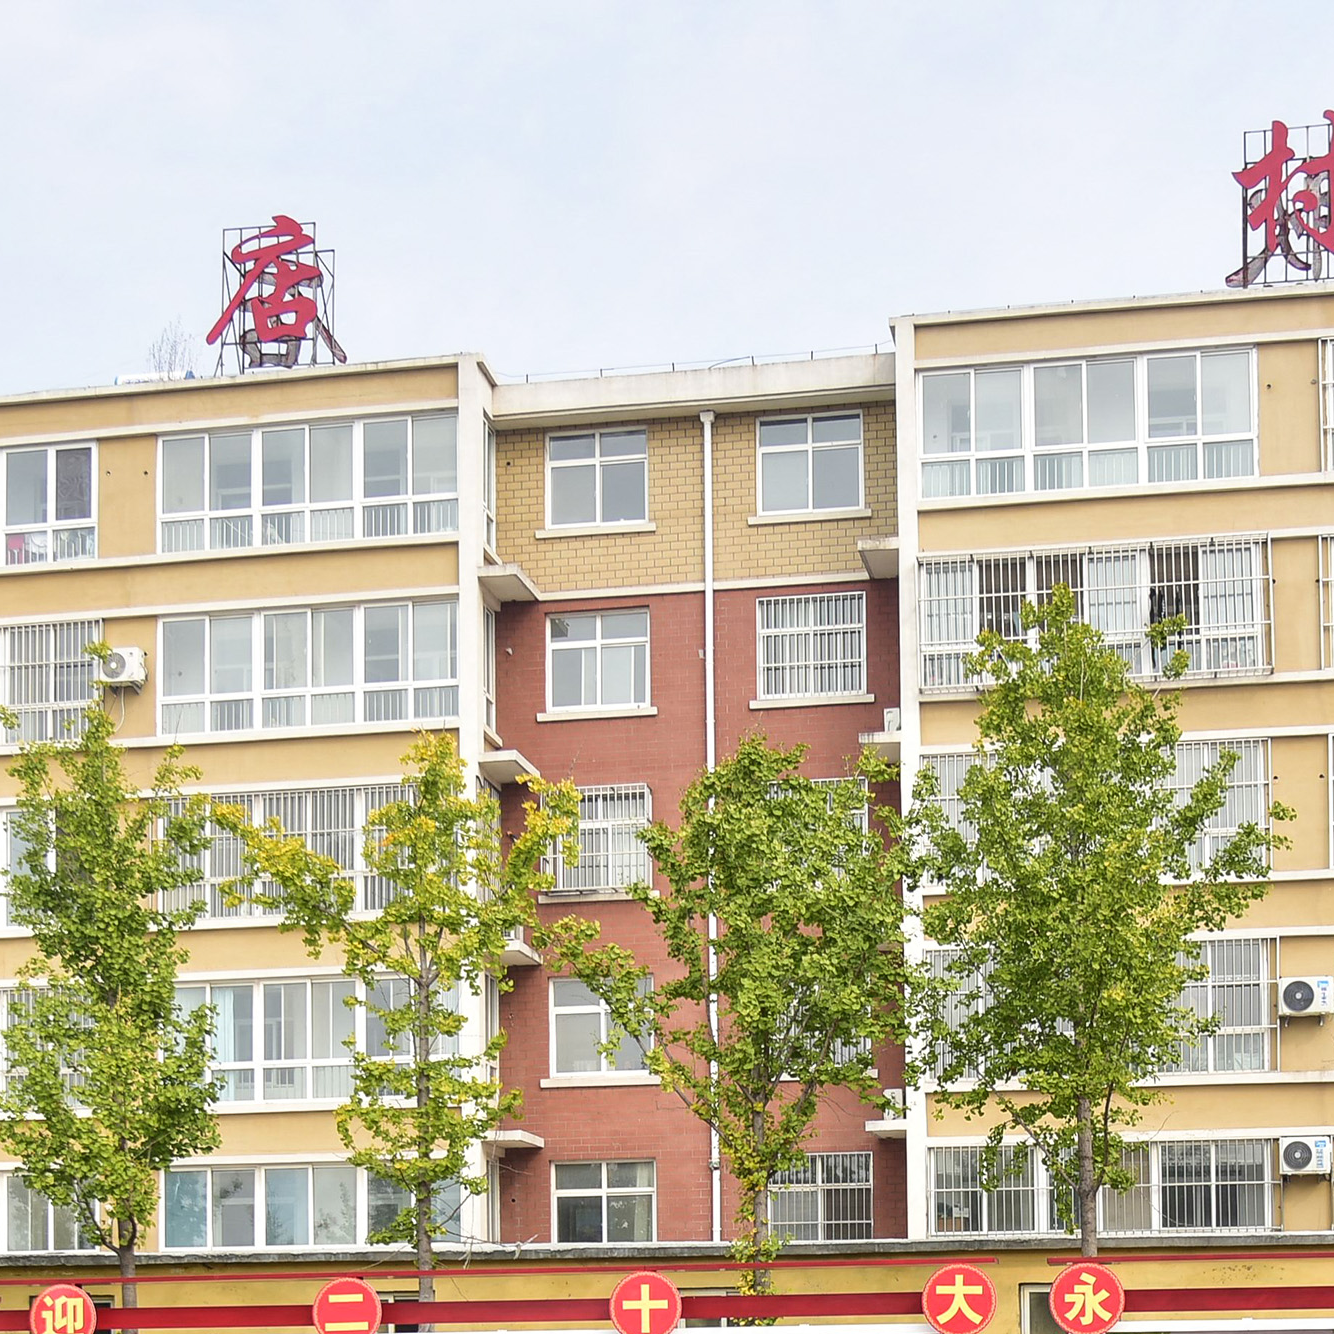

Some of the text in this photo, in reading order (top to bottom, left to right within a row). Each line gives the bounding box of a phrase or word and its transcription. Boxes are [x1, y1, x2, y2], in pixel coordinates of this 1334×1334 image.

[206, 215, 324, 345] 店
[324, 1293, 369, 1332] 二
[622, 1284, 669, 1334] 十
[935, 1275, 985, 1325] 大
[1063, 1273, 1113, 1327] 永
